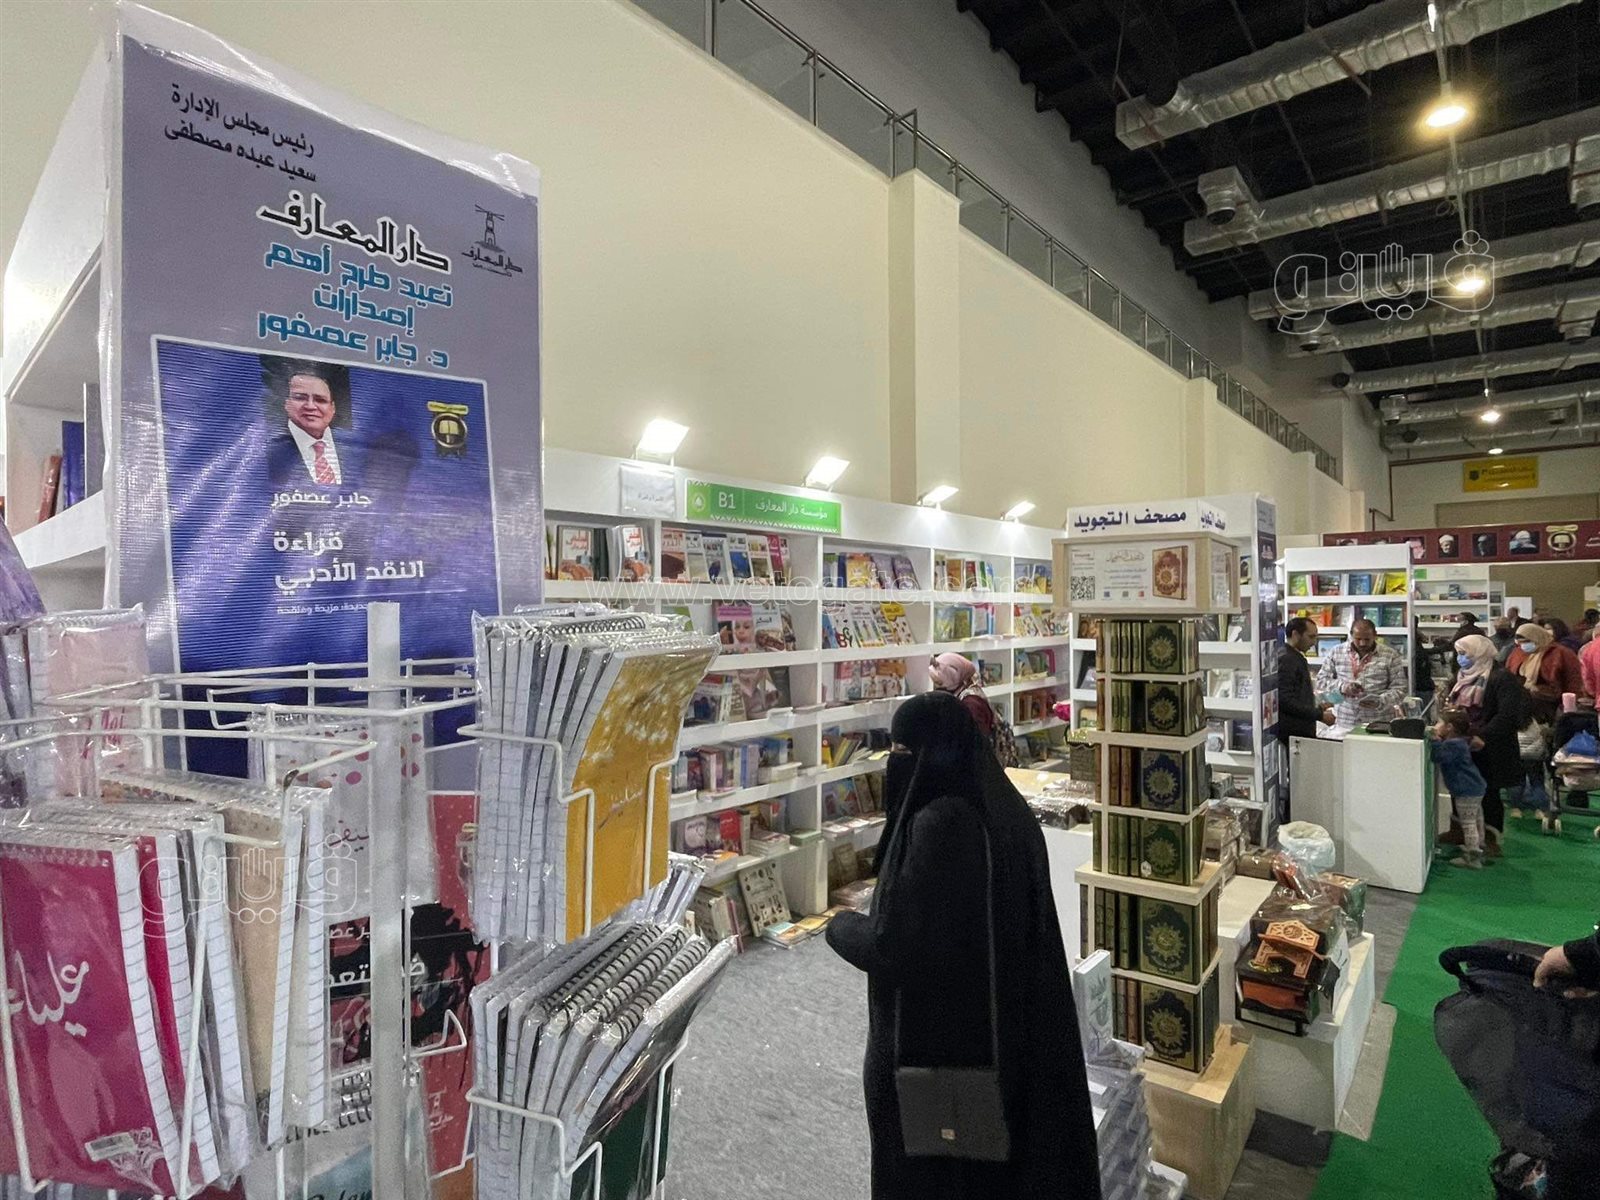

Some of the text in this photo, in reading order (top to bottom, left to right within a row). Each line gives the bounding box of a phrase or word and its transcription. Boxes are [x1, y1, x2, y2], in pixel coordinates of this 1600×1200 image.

[172, 83, 314, 158] رئيس مجلس الإدارة
[237, 145, 274, 168] عبده
[279, 160, 316, 181] سعيد
[265, 243, 452, 307] تعيد طرح أهم
[313, 283, 414, 337] إصدارات
[257, 312, 367, 350] عصفور
[376, 334, 417, 366] جابر
[271, 490, 373, 509] جابر عصفور
[719, 492, 736, 509] B1
[755, 497, 788, 512] المعارف
[788, 503, 800, 515] دار
[1074, 508, 1187, 532] مصحف التجويد
[273, 531, 343, 556] قراءة
[275, 558, 425, 596] النقد الأدبي
